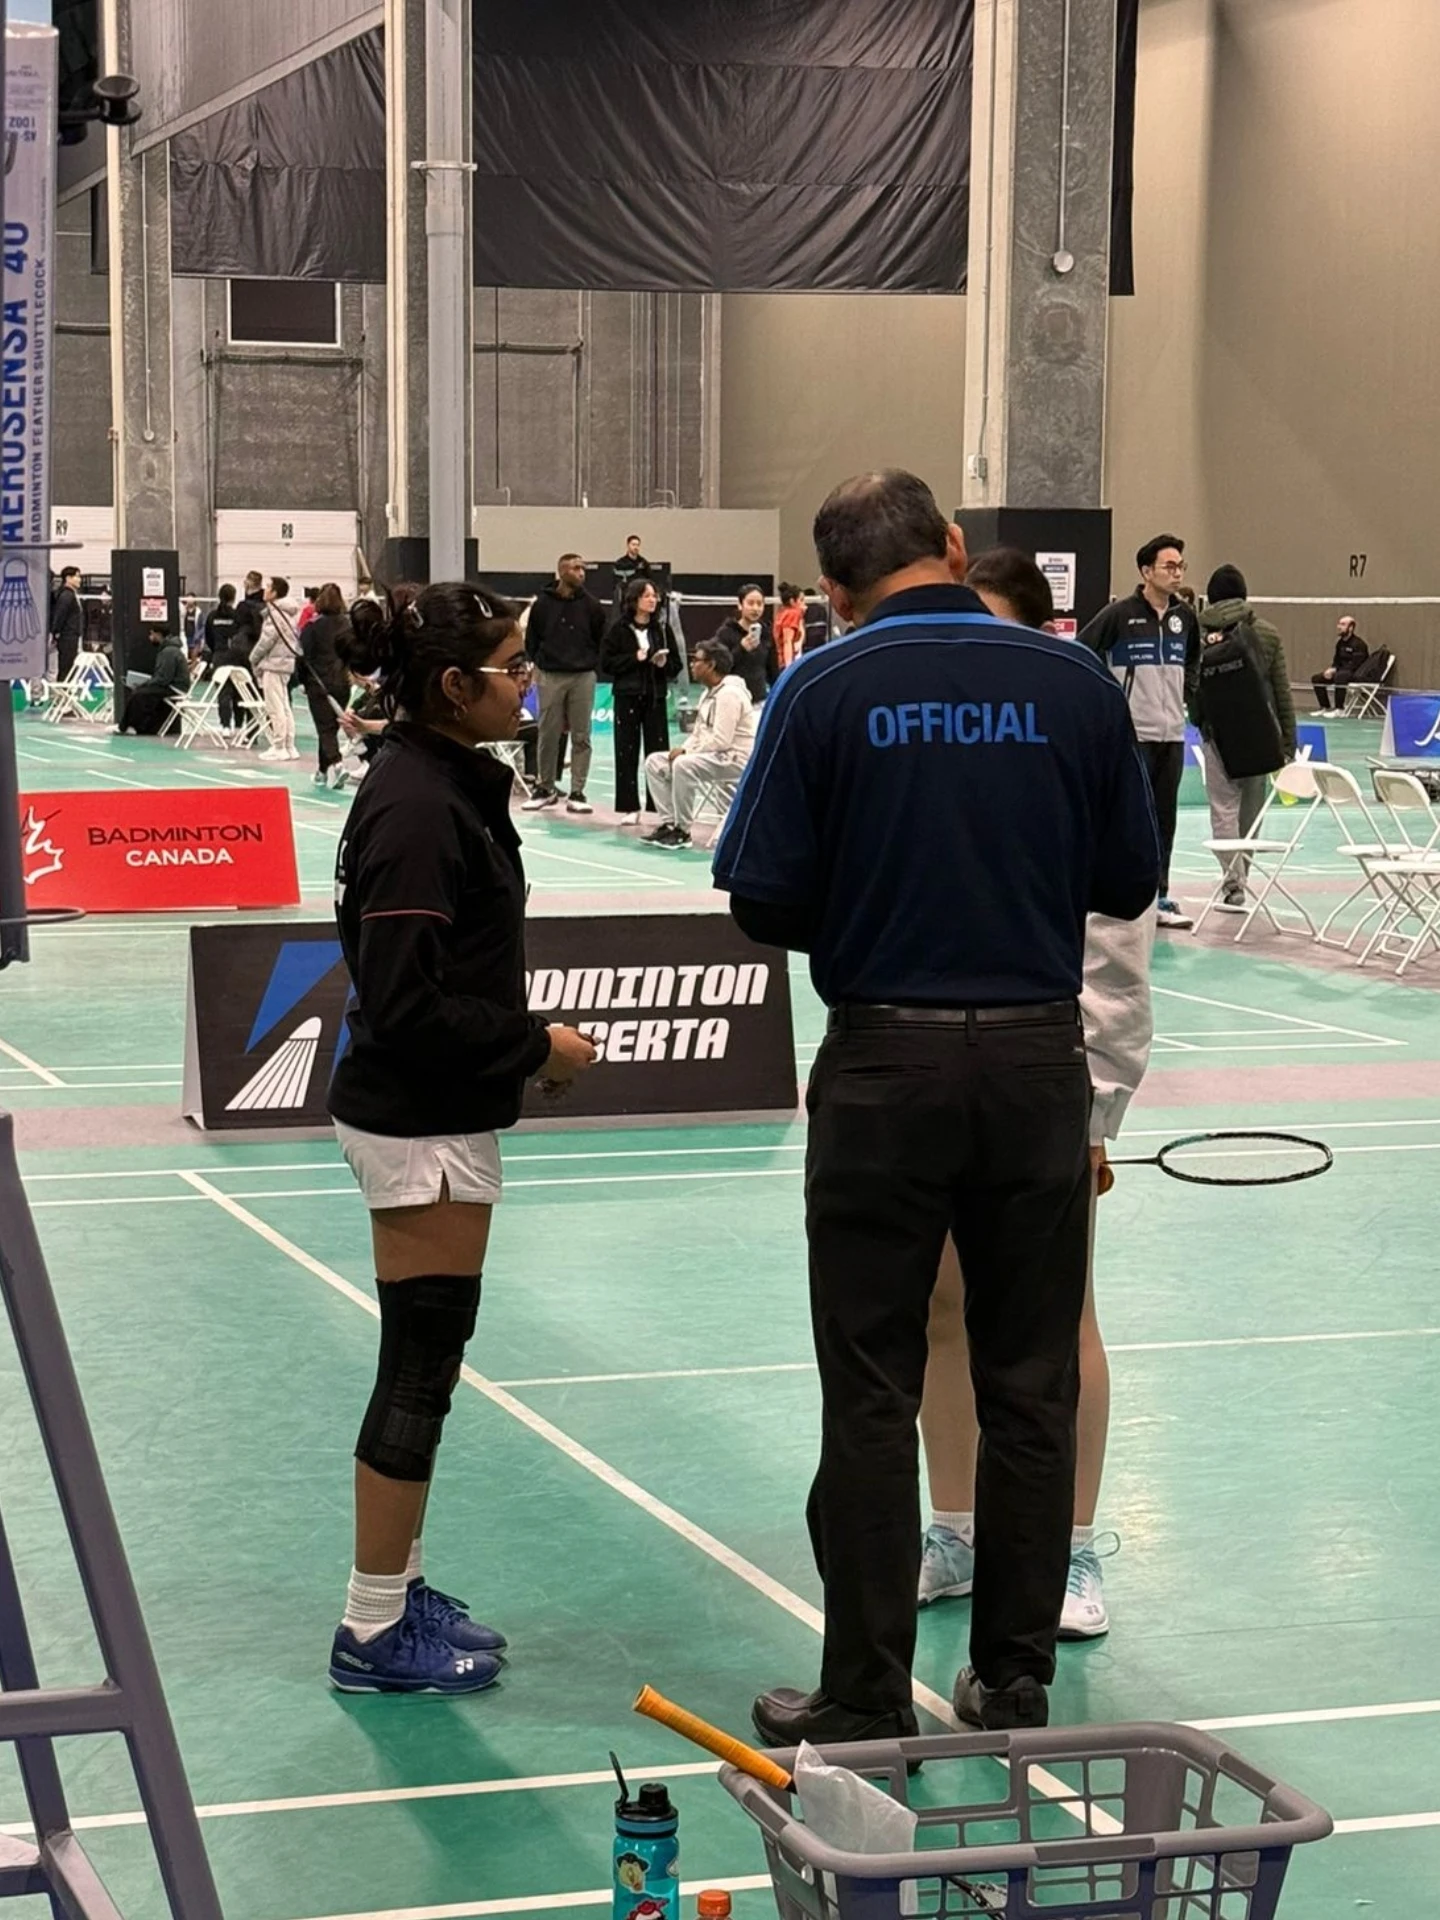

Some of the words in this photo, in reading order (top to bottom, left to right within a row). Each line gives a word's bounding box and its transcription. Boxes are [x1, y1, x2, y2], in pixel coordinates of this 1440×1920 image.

[33, 258, 46, 371] SHUTTLECOCK
[3, 299, 28, 543] AEROSENSA
[32, 375, 44, 446] FEATHER
[31, 452, 43, 543] BADMINTON
[56, 519, 68, 536] R9
[281, 523, 294, 539] R8
[1350, 554, 1367, 578] R7
[867, 702, 1048, 748] OFFICIAL
[88, 824, 263, 846] BADMINTON
[126, 848, 234, 867] CANADA
[526, 964, 769, 1011] DMINTON
[551, 1018, 730, 1064] BERTA
